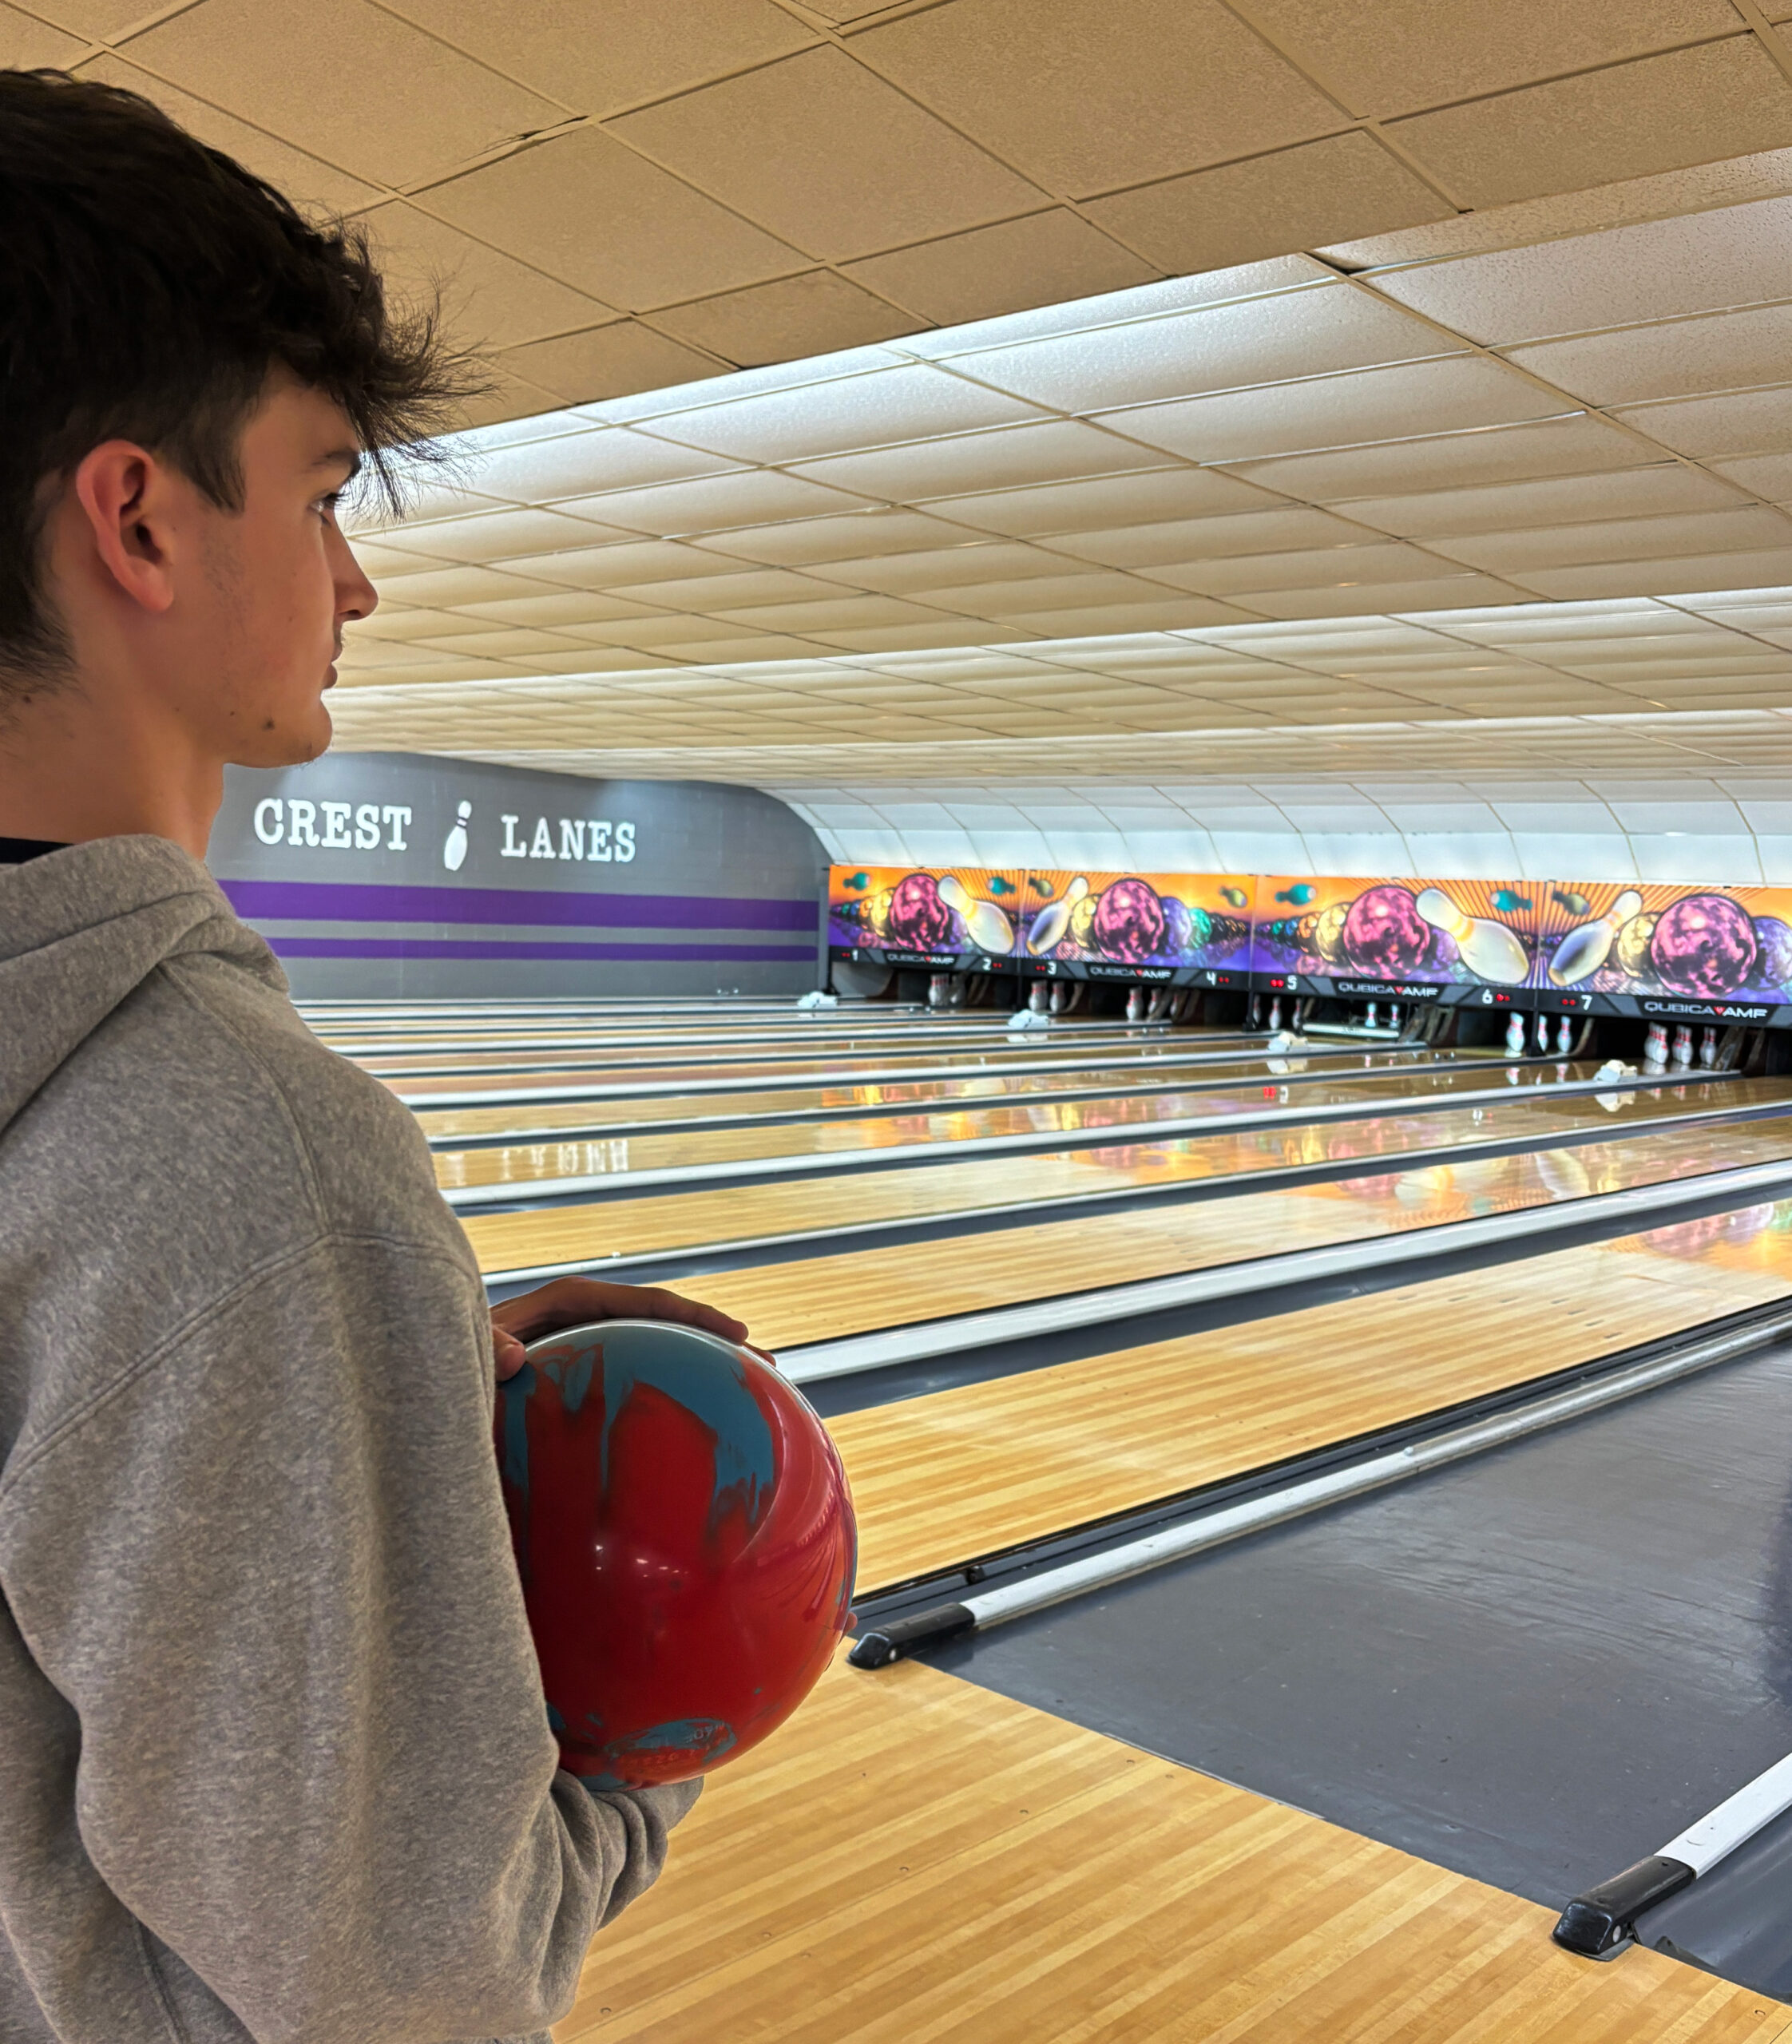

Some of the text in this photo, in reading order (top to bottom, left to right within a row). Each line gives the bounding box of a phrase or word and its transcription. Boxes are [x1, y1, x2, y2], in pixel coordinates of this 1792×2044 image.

[254, 798, 636, 863] CREST LANES
[852, 949, 858, 961] 1
[982, 958, 992, 971] 2
[1048, 961, 1057, 975] 3
[1207, 972, 1216, 986] 4
[1287, 976, 1297, 990] 5
[1482, 989, 1493, 1004] 6
[1581, 995, 1592, 1011] 7
